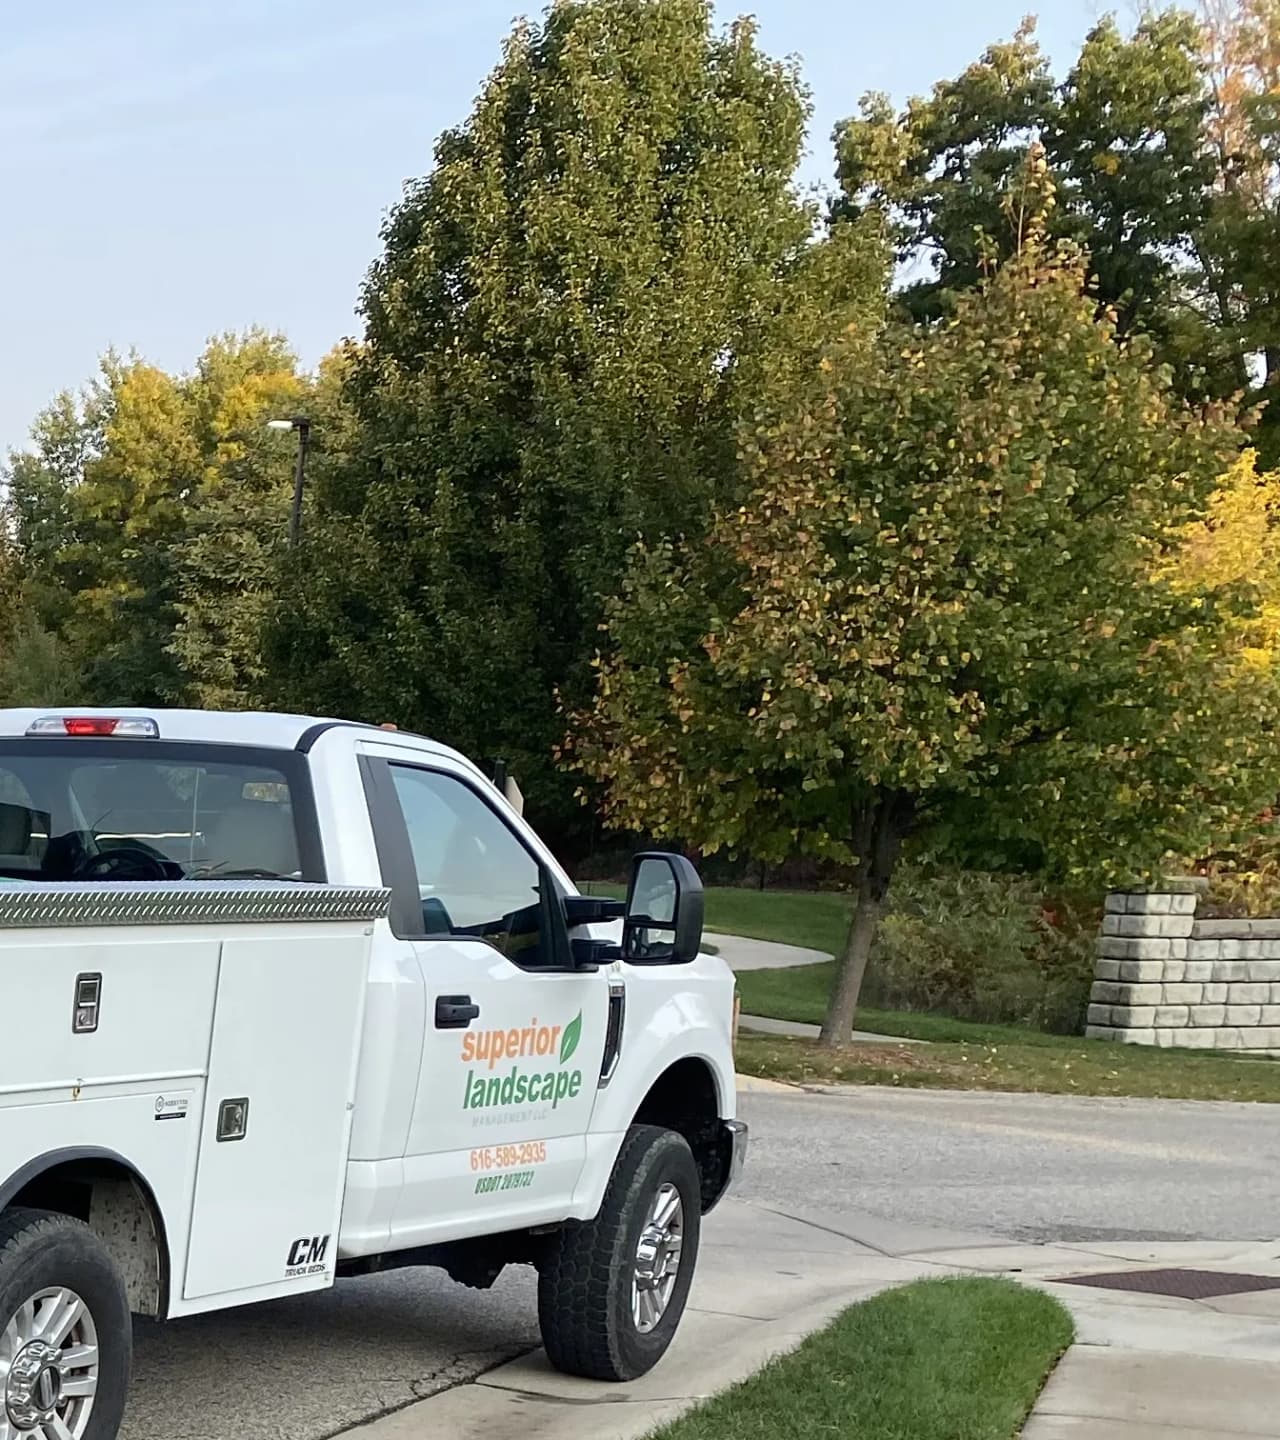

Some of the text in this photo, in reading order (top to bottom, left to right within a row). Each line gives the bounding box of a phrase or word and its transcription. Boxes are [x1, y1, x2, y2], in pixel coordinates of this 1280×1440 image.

[461, 1017, 561, 1070] superior
[463, 1066, 582, 1109] landscape
[470, 1141, 546, 1171] 616-589-2935
[474, 1174, 502, 1195] USDOT
[287, 1234, 331, 1266] CM
[285, 1266, 307, 1277] TRUCK
